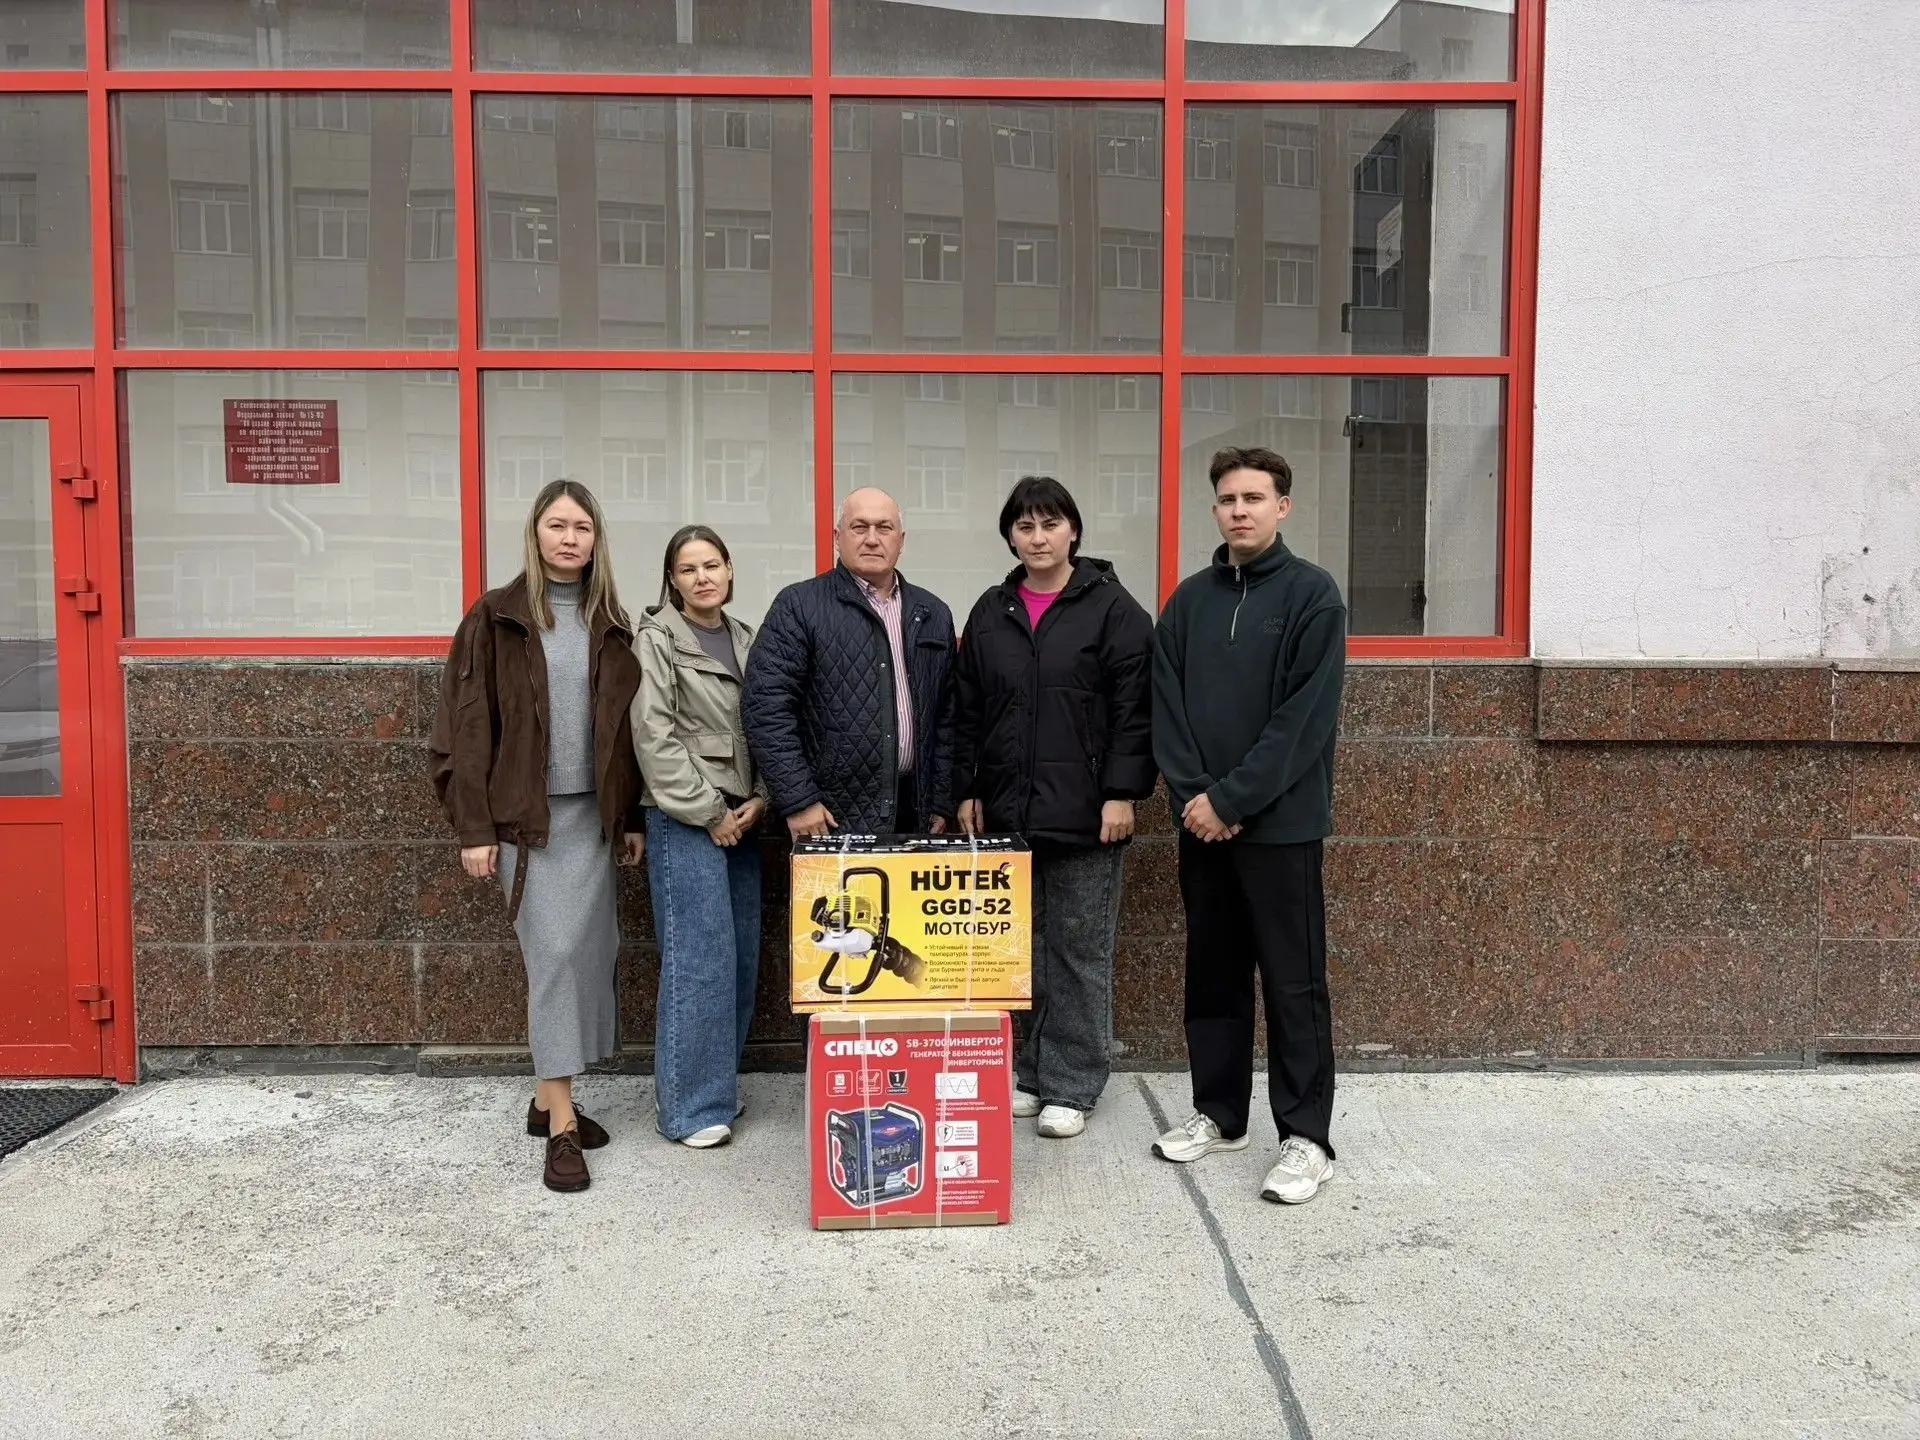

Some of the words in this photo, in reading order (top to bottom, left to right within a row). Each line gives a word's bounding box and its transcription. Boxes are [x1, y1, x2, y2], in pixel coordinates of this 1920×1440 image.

[911, 864, 1011, 891] HÜTER
[921, 898, 1011, 915] GGD-52
[924, 921, 1011, 935] МОТОБУР
[952, 1049, 1003, 1057] БЕНЗИНОВЫЙ
[894, 1073, 900, 1083] 1
